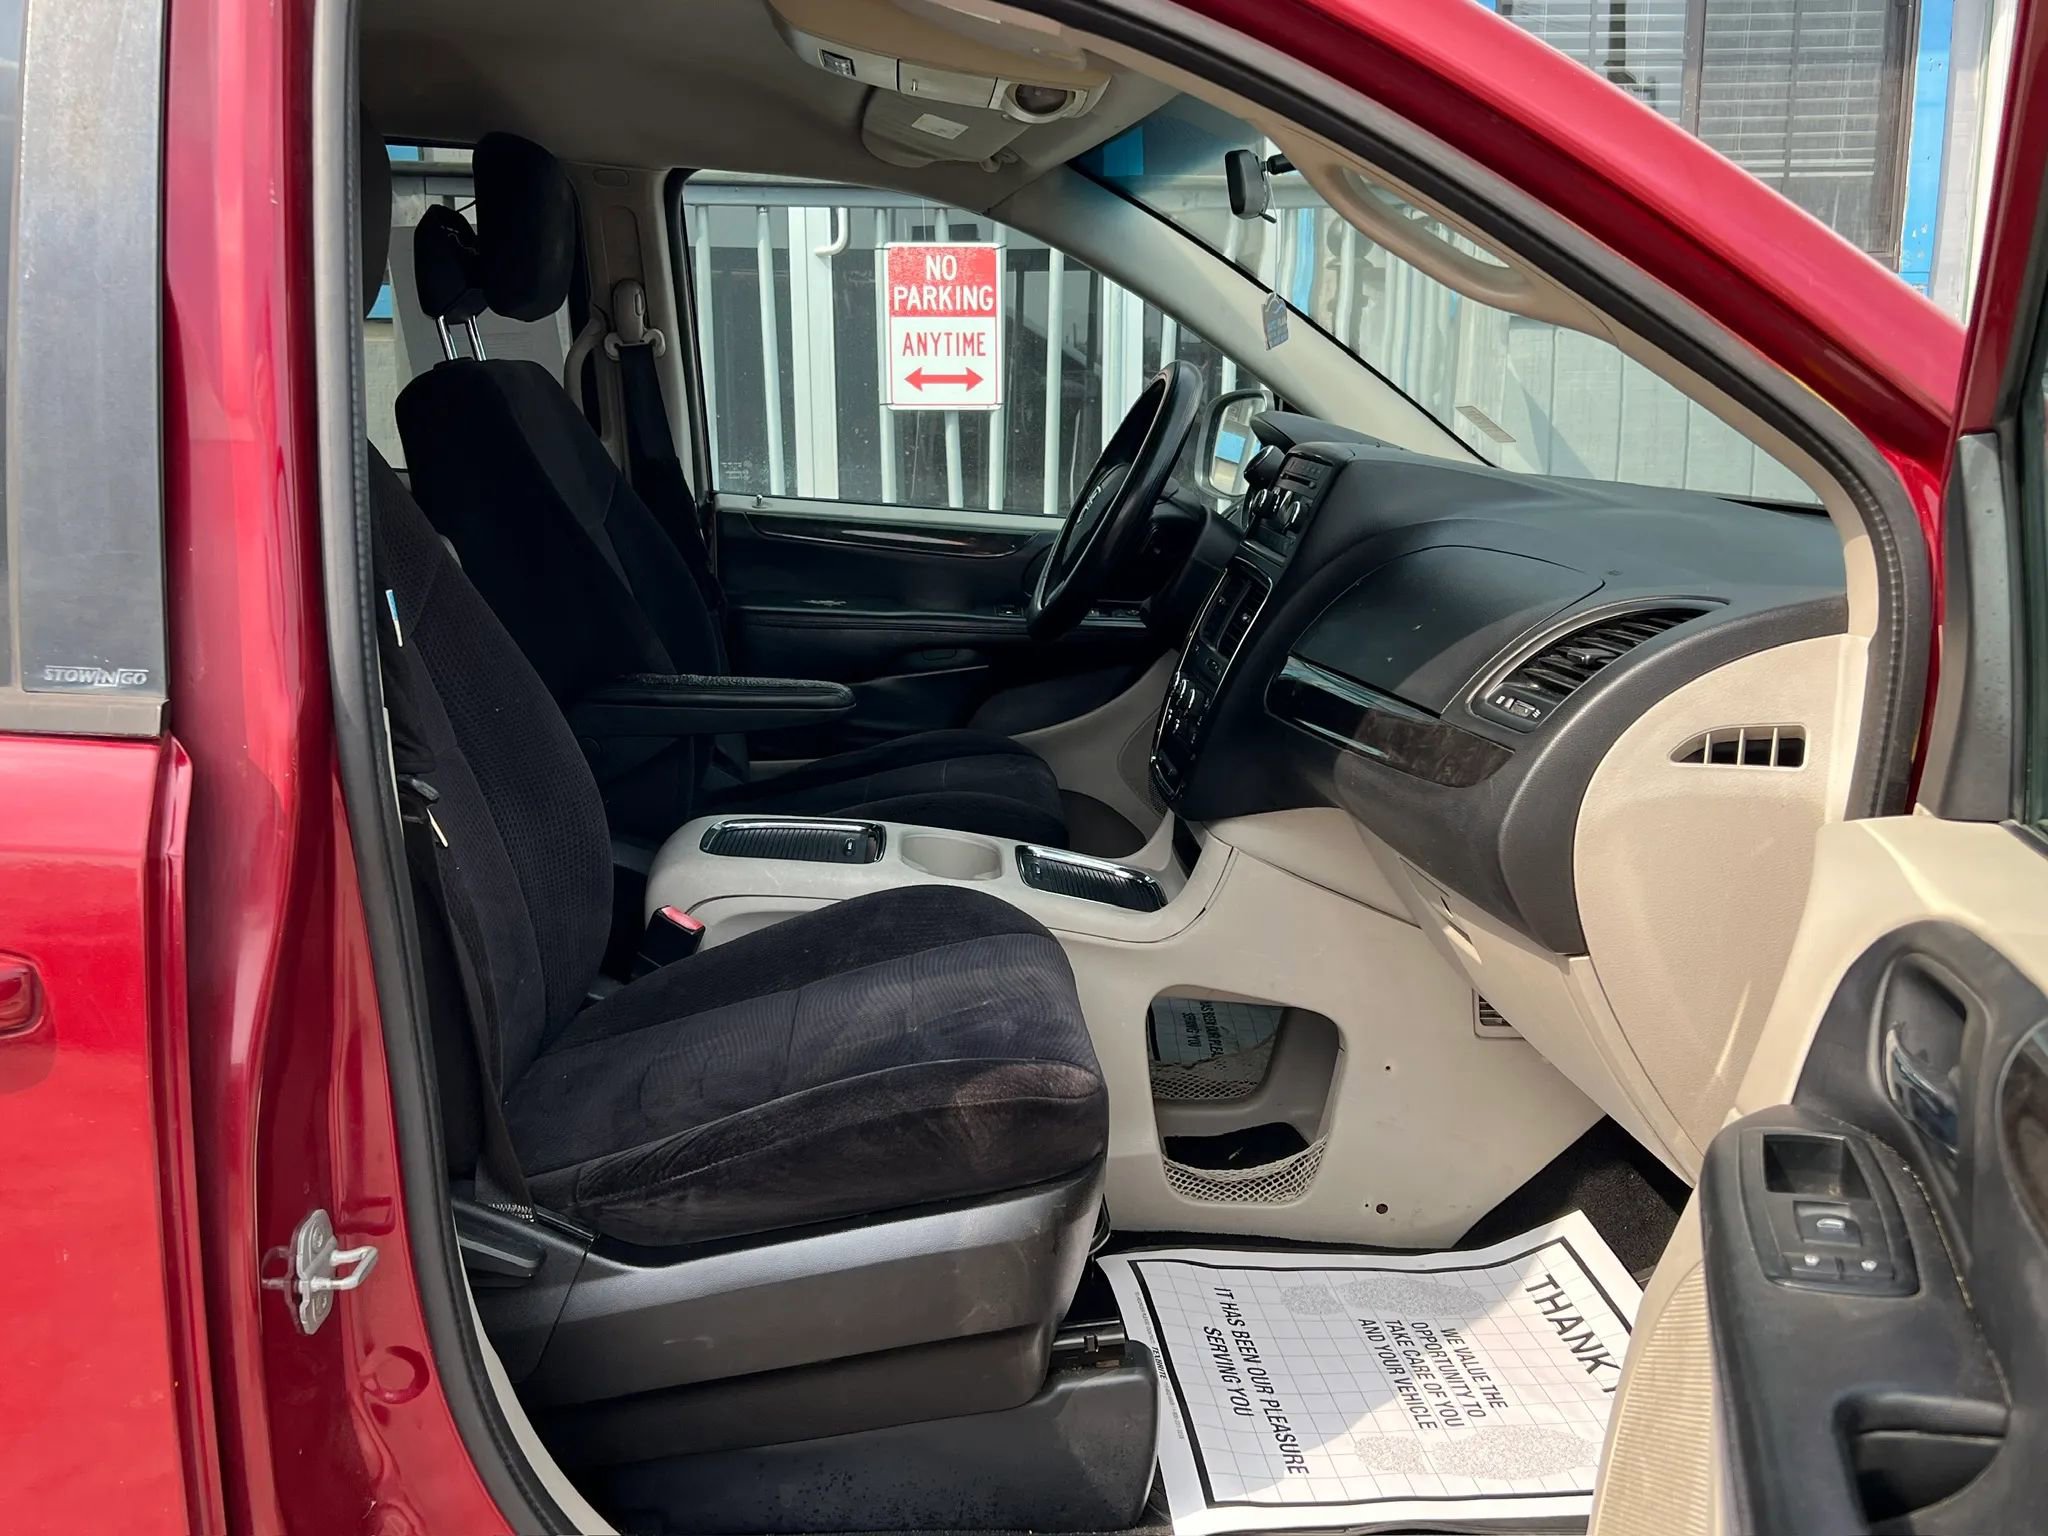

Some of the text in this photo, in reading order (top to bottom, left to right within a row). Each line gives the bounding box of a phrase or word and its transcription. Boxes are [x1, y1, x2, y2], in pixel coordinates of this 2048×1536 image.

[893, 285, 994, 311] PARKING
[925, 254, 958, 281] NO
[902, 332, 987, 357] ANYTIME
[1411, 1322, 1486, 1418] OPPORTUNITY TO
[1440, 1328, 1509, 1409] WE VALUE THE
[1525, 1273, 1621, 1375] THANK
[1203, 1326, 1255, 1416] SERVING YOU
[1214, 1287, 1310, 1474] IT HAS BEEN OUR PLEASURE
[1358, 1318, 1438, 1430] AND YOUR VEHICLE
[1385, 1319, 1465, 1427] TAKE CARE OF YOU
